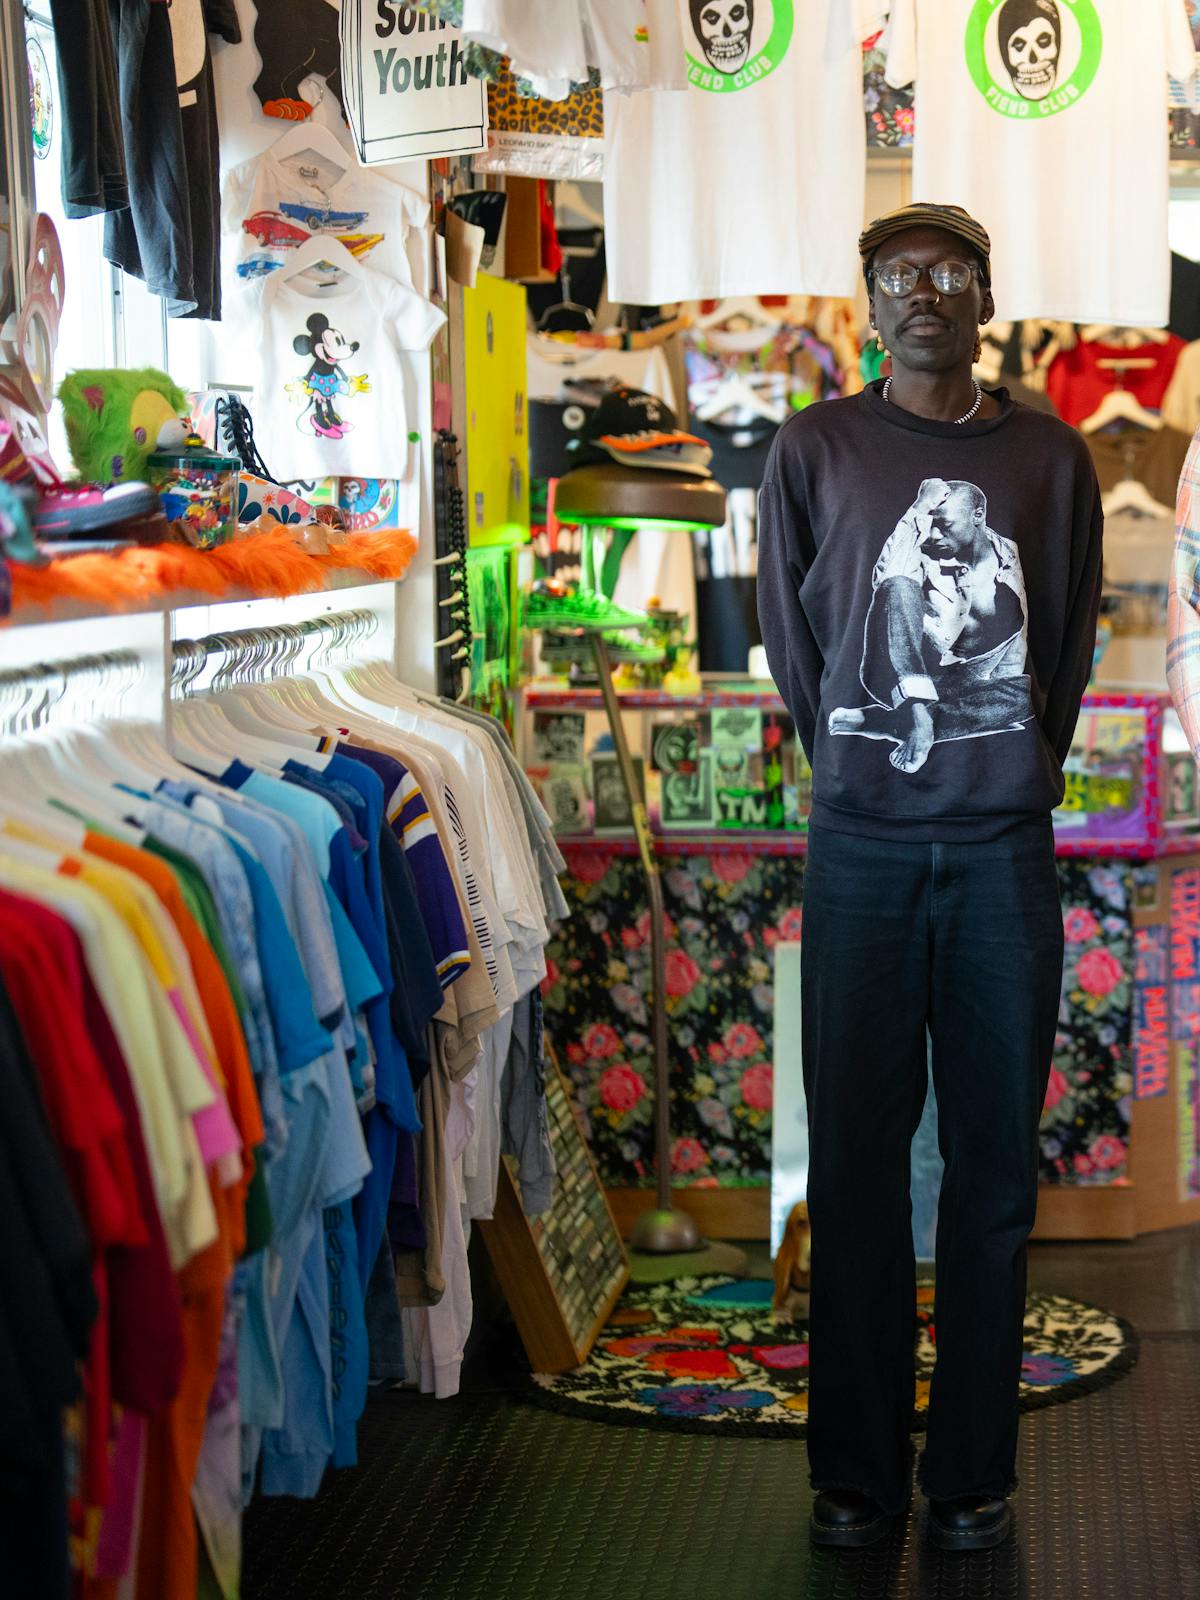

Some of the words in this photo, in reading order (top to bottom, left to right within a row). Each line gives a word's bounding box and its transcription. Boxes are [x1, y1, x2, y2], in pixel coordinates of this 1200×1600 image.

[375, 0, 458, 38] Son
[373, 39, 468, 95] Youth
[733, 56, 773, 88] CLUB
[986, 85, 1030, 116] FIEND
[1038, 83, 1080, 115] CLUB
